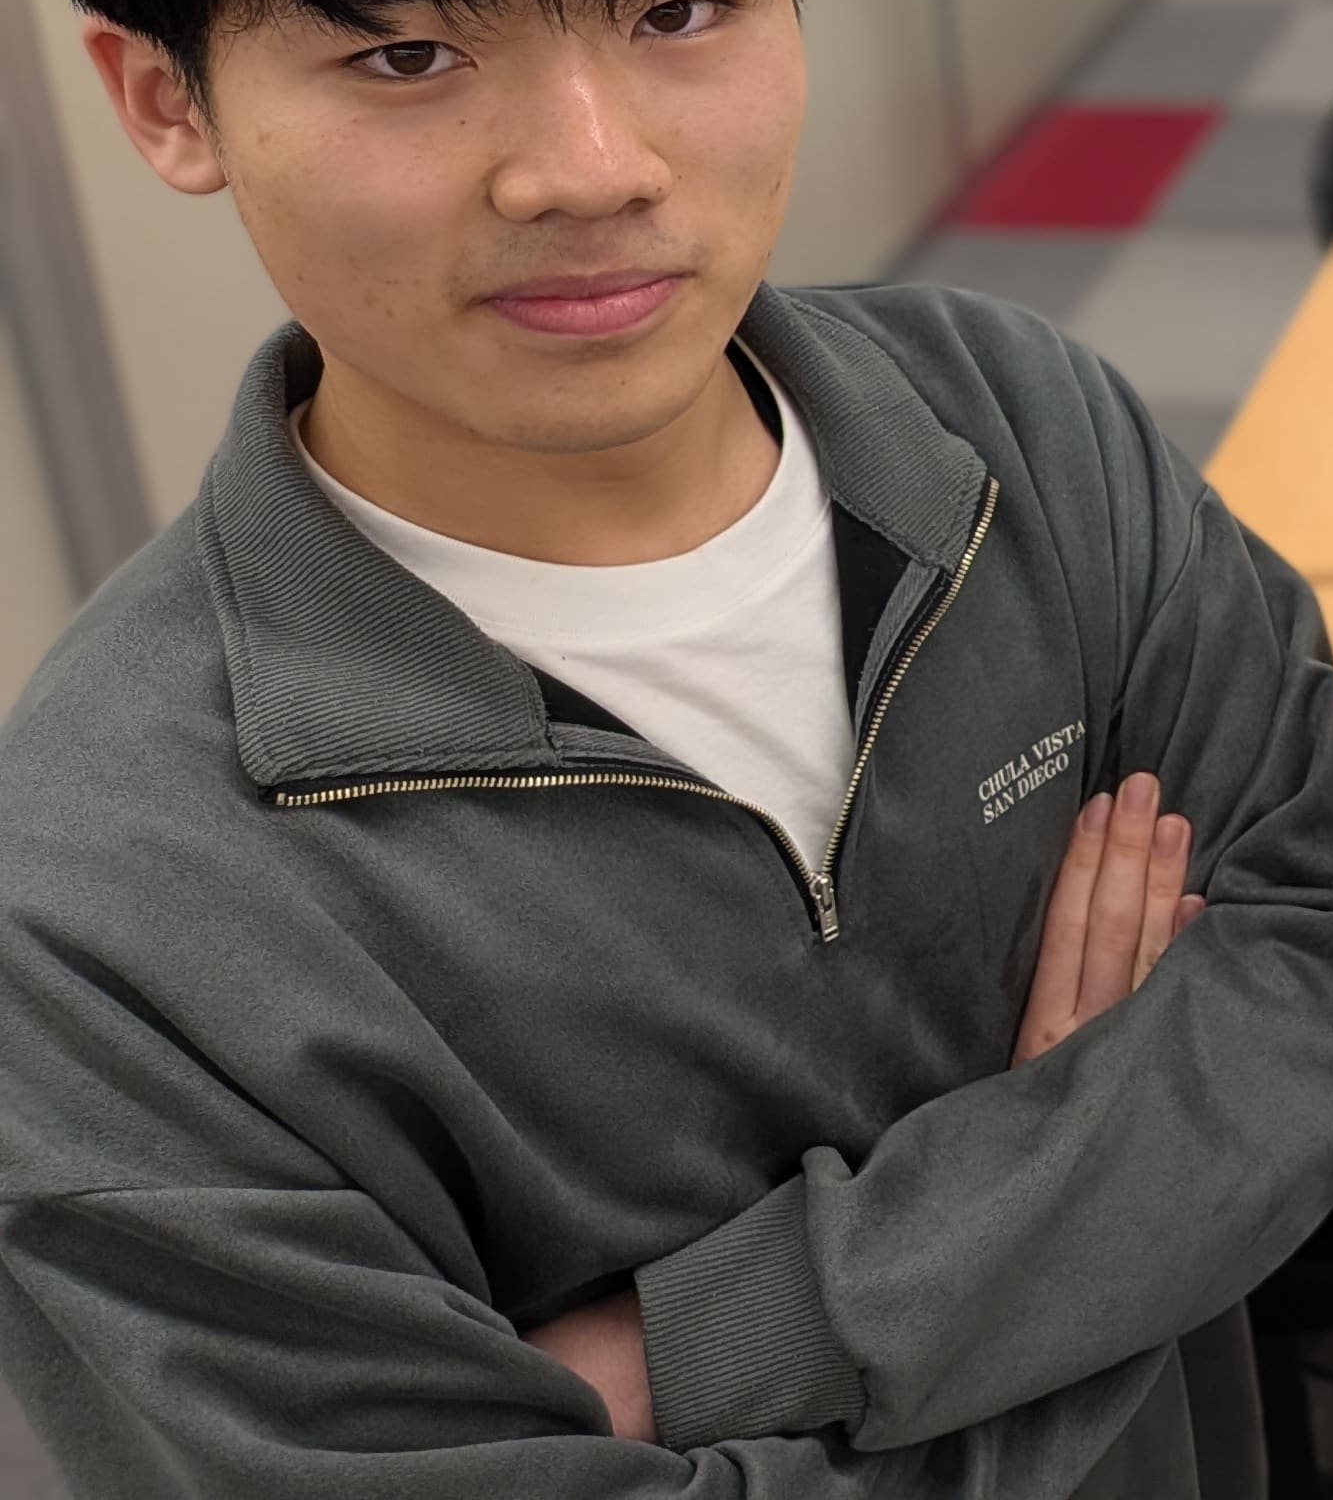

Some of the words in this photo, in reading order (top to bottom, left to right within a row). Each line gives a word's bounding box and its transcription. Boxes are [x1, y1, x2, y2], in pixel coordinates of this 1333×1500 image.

[978, 753, 1031, 801] CHULA
[1031, 719, 1086, 761] VISTA
[983, 787, 1015, 825] SAN
[1017, 752, 1069, 799] DIEGO
